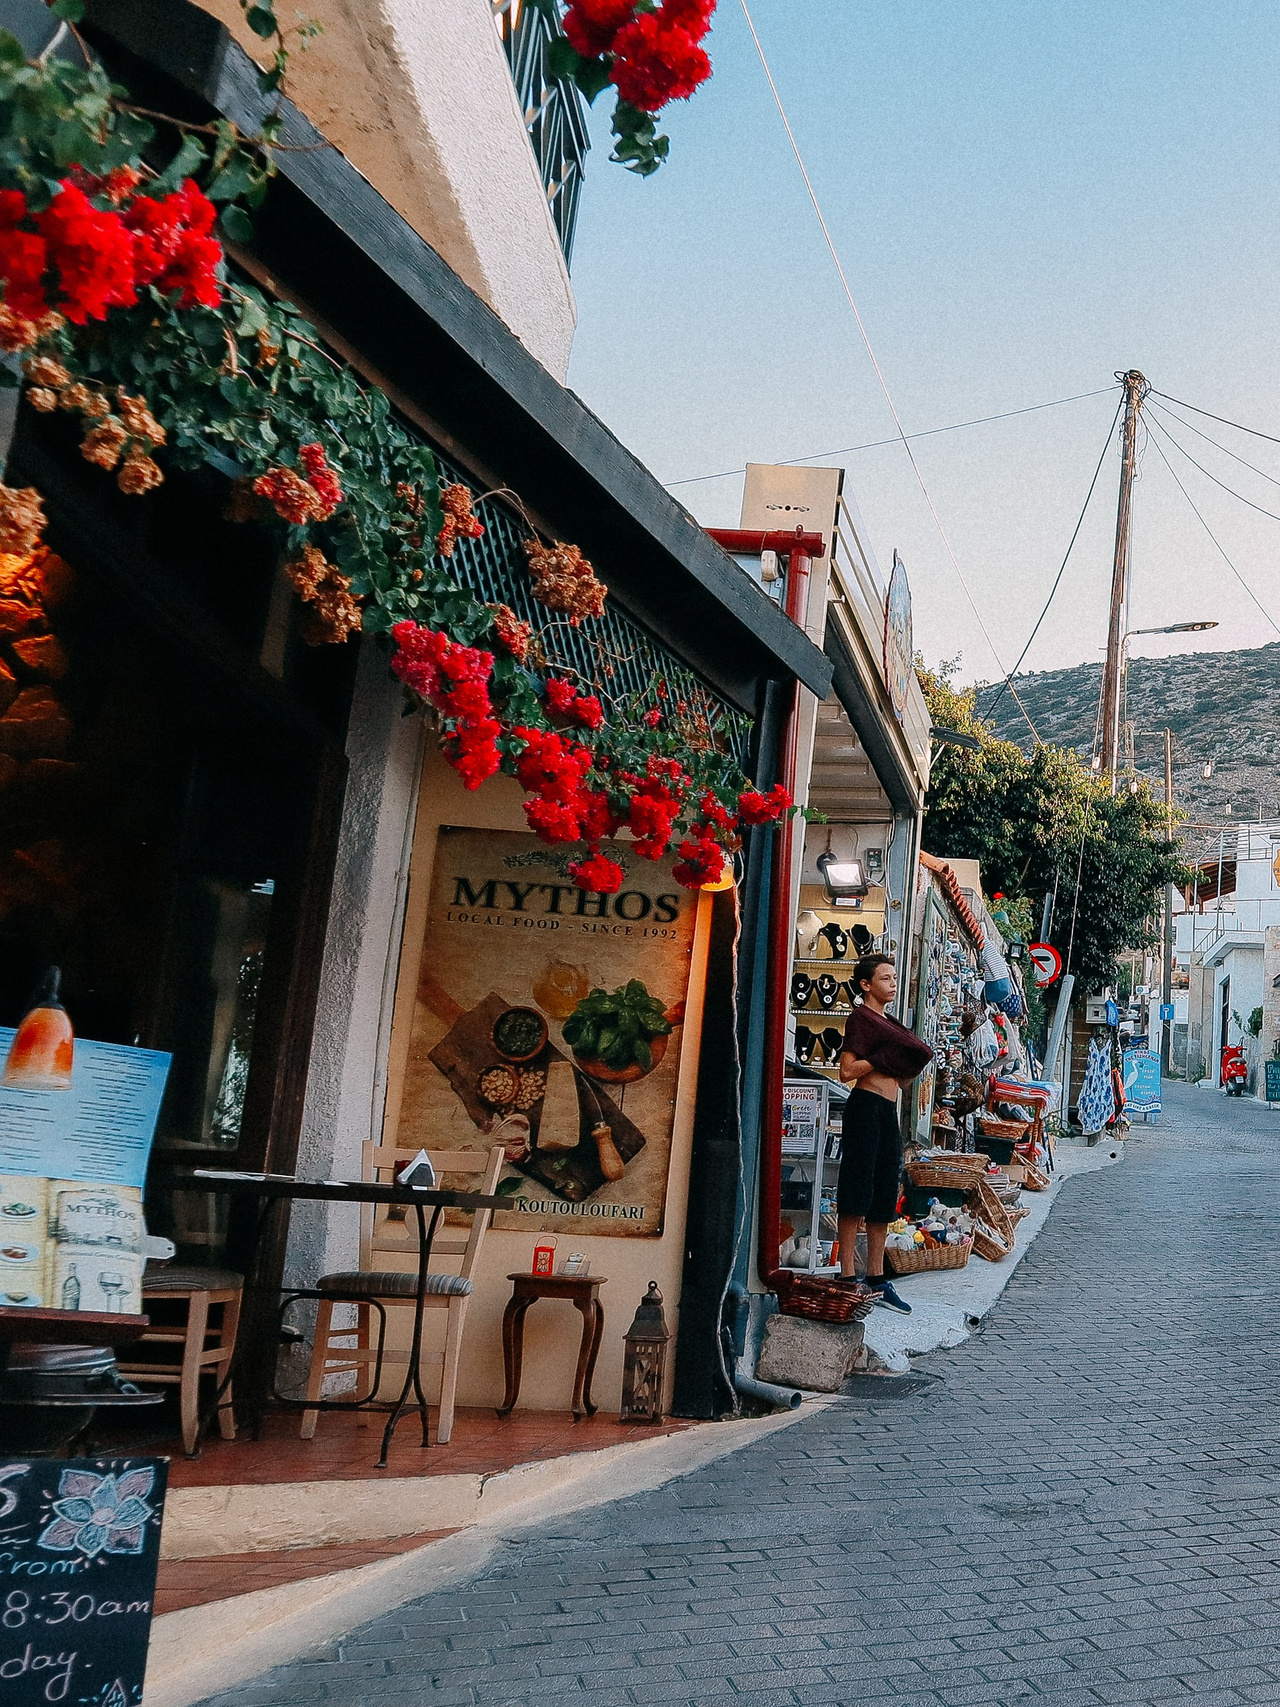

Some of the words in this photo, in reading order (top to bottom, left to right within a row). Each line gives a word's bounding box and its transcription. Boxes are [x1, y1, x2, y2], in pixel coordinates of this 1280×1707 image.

[450, 877, 681, 923] MYTHOS
[446, 911, 505, 926] LOCAL
[512, 917, 561, 930] FOOD
[581, 922, 634, 936] SINCE
[642, 927, 678, 940] 1992
[65, 1204, 137, 1221] MYTHOS
[518, 1200, 645, 1219] KOUTOULOUFARI
